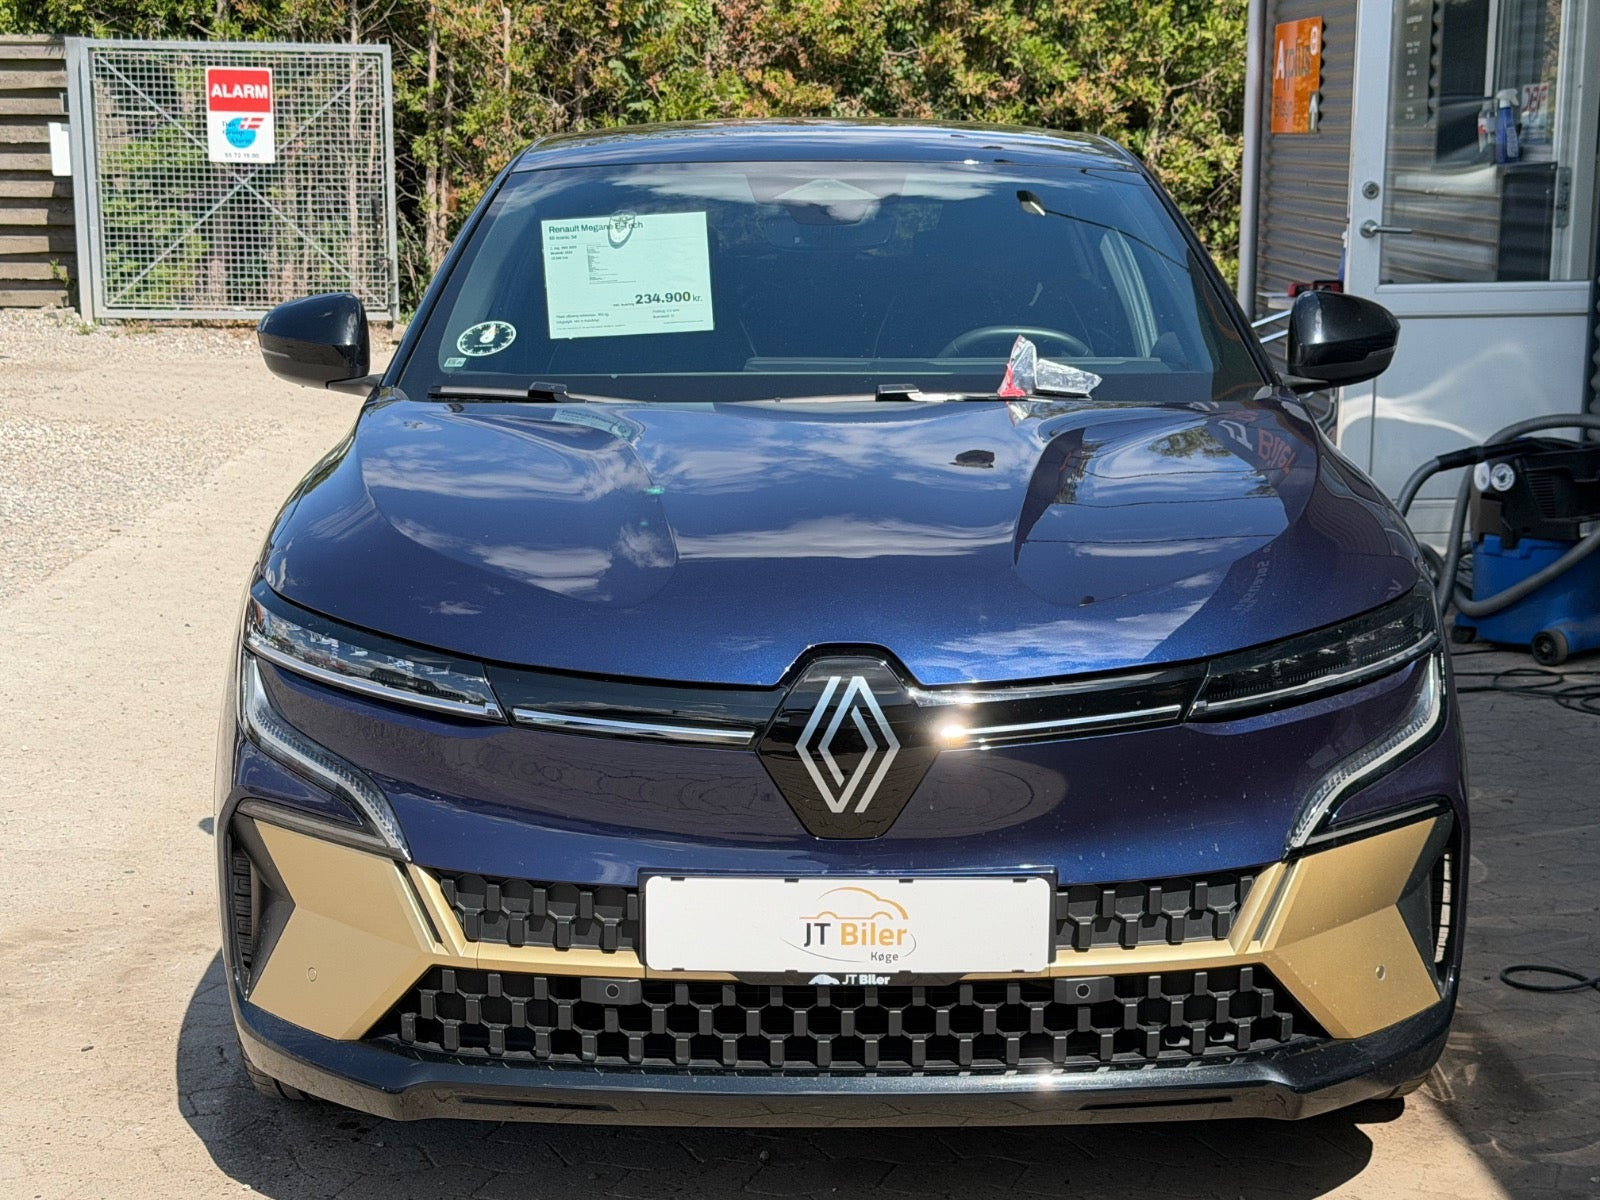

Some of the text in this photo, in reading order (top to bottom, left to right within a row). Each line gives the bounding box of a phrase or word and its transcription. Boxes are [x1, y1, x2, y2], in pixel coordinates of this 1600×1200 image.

[211, 83, 268, 99] ALARM
[548, 224, 580, 234] Renault
[635, 291, 691, 305] 234.900
[692, 294, 703, 302] kr.
[803, 922, 908, 948] JT Biler
[870, 951, 899, 964] Køge
[841, 974, 891, 985] JT Biler
